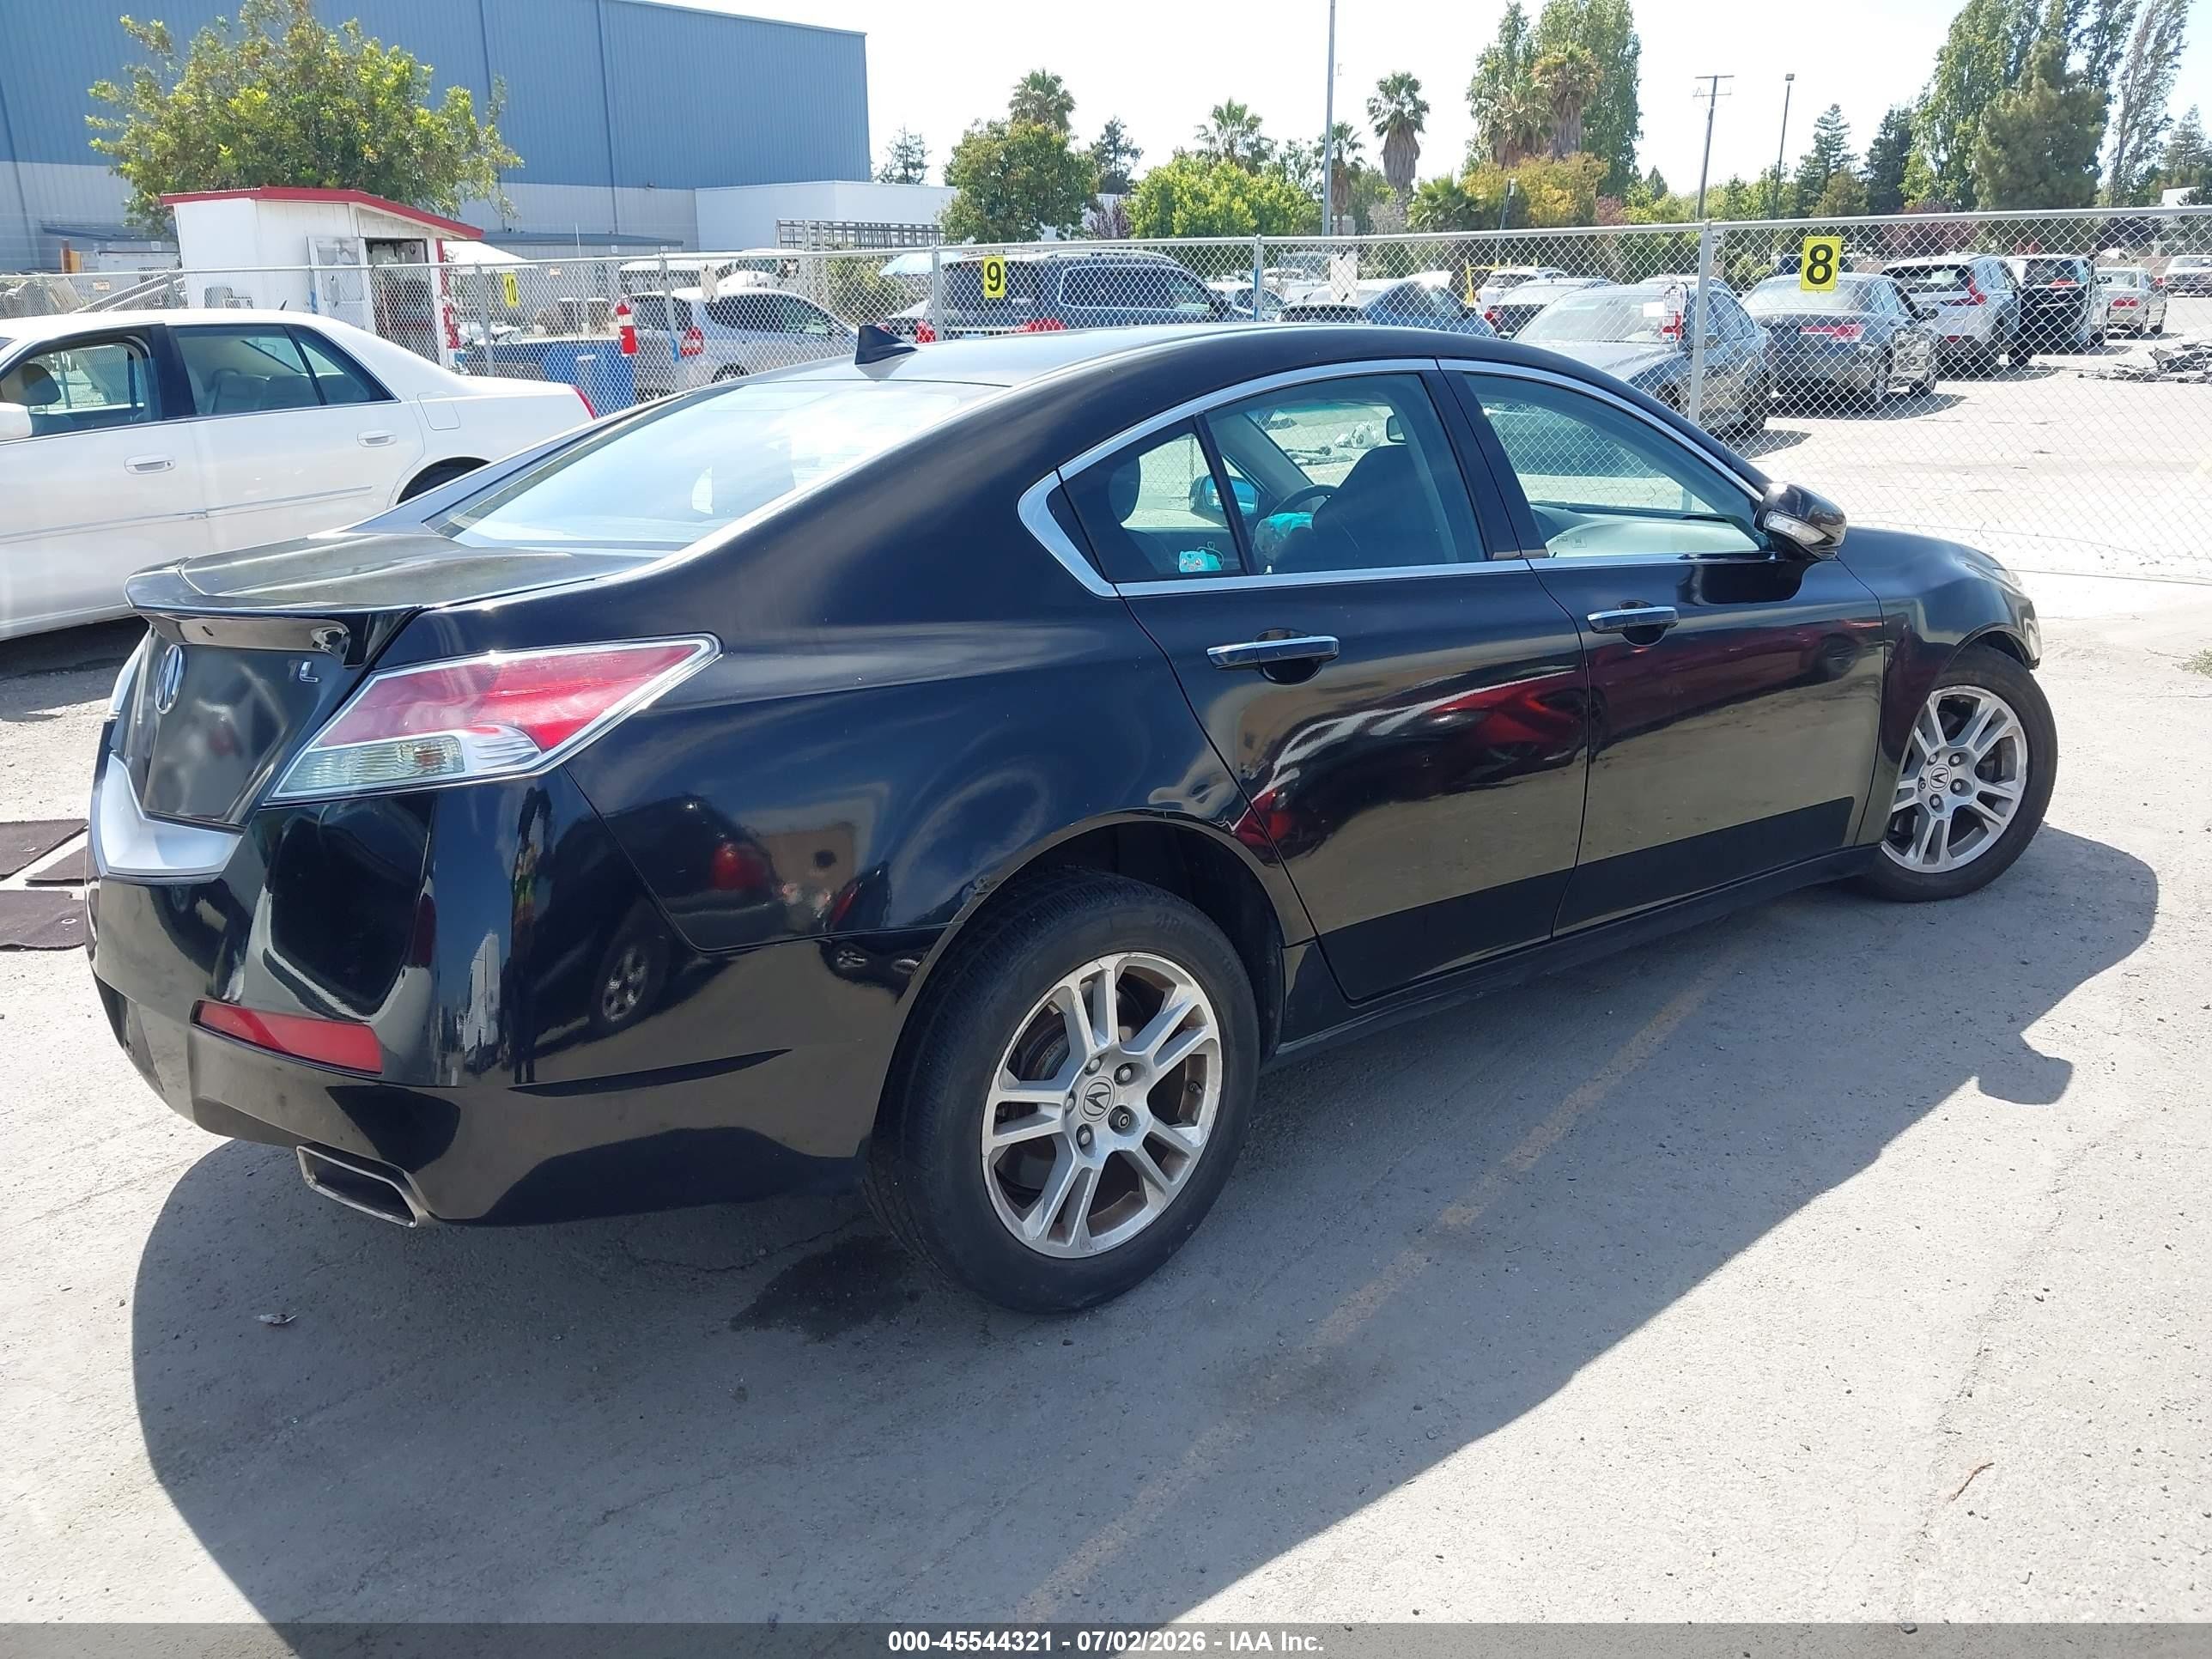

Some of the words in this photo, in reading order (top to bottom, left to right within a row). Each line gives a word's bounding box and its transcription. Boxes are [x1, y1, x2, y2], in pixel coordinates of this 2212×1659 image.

[987, 261, 1001, 292] 9
[1806, 244, 1833, 285] 8
[506, 277, 517, 302] 10
[288, 659, 318, 683] TL
